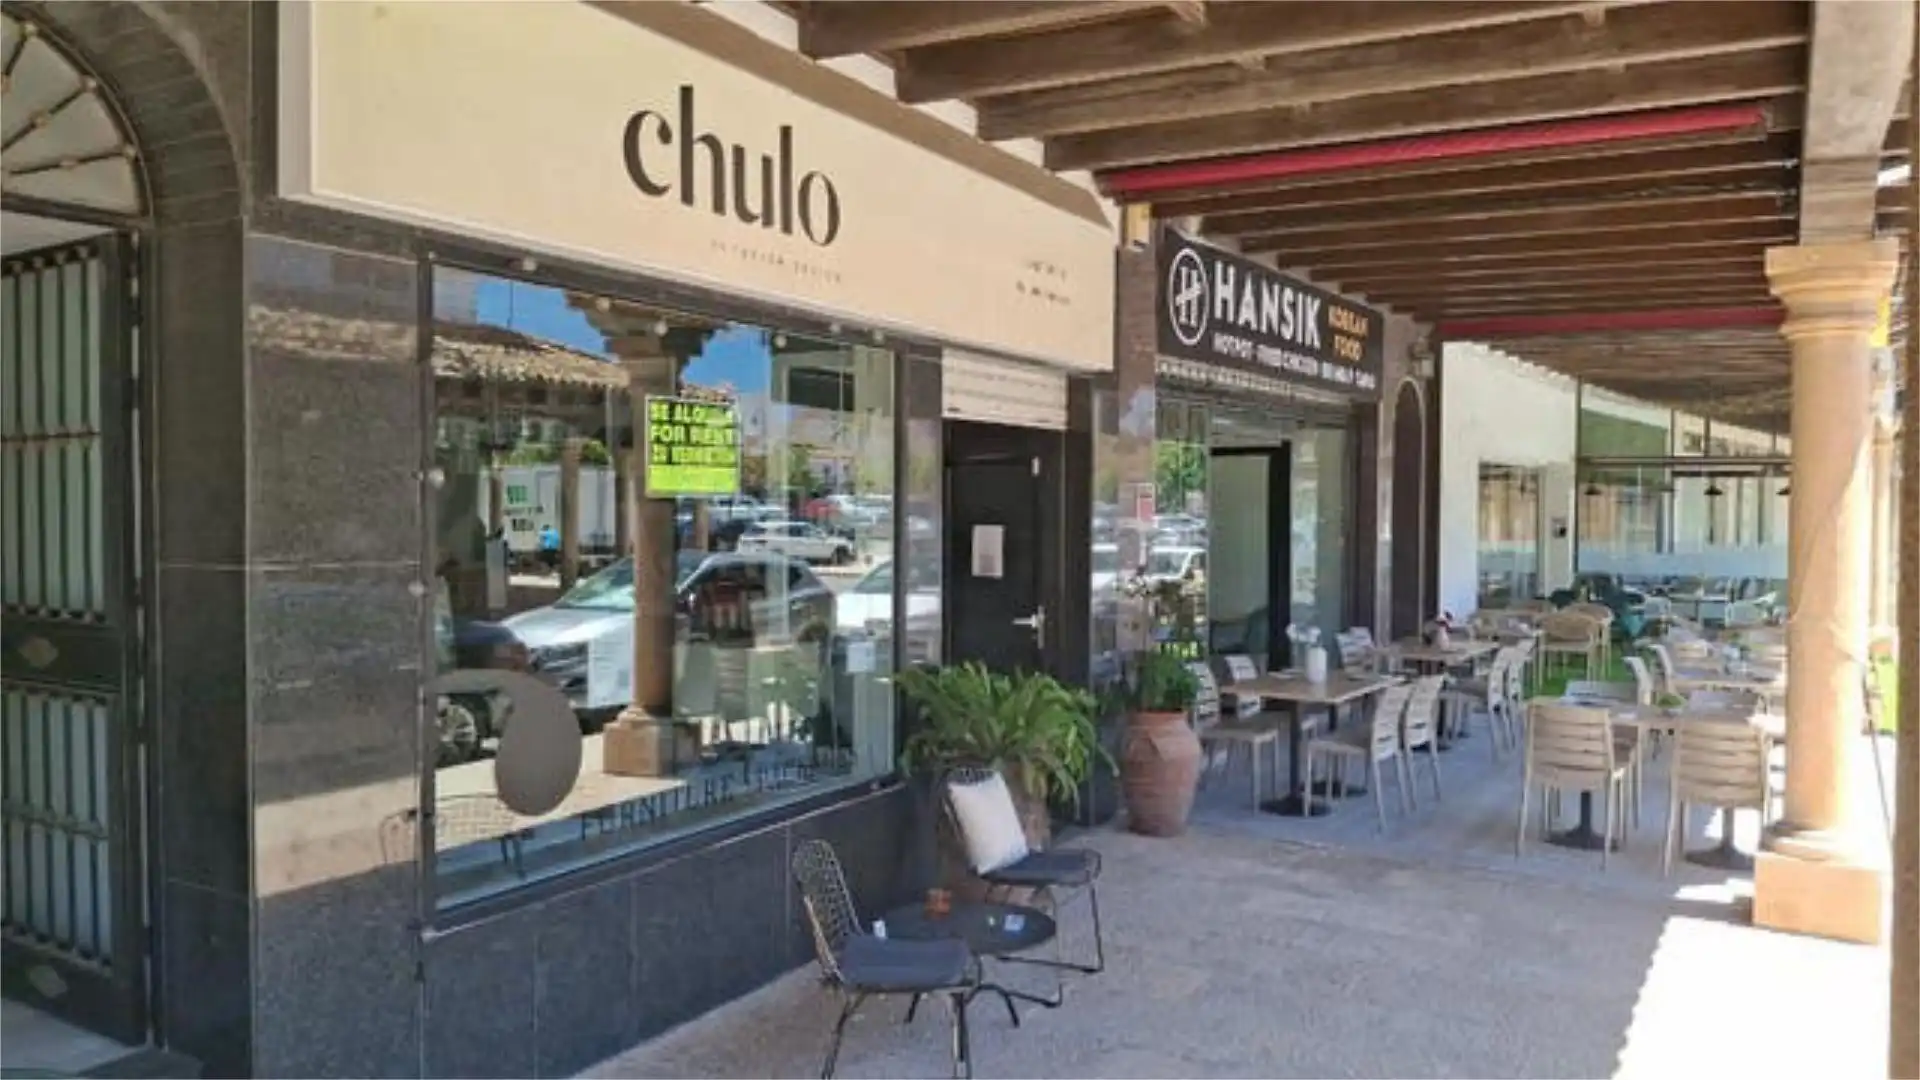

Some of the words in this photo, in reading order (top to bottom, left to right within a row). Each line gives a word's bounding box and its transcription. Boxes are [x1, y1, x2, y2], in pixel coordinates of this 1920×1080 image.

[623, 85, 841, 247] chulo
[1213, 260, 1321, 349] HANSIK
[1335, 335, 1363, 361] FOOD
[651, 425, 685, 443] FOR
